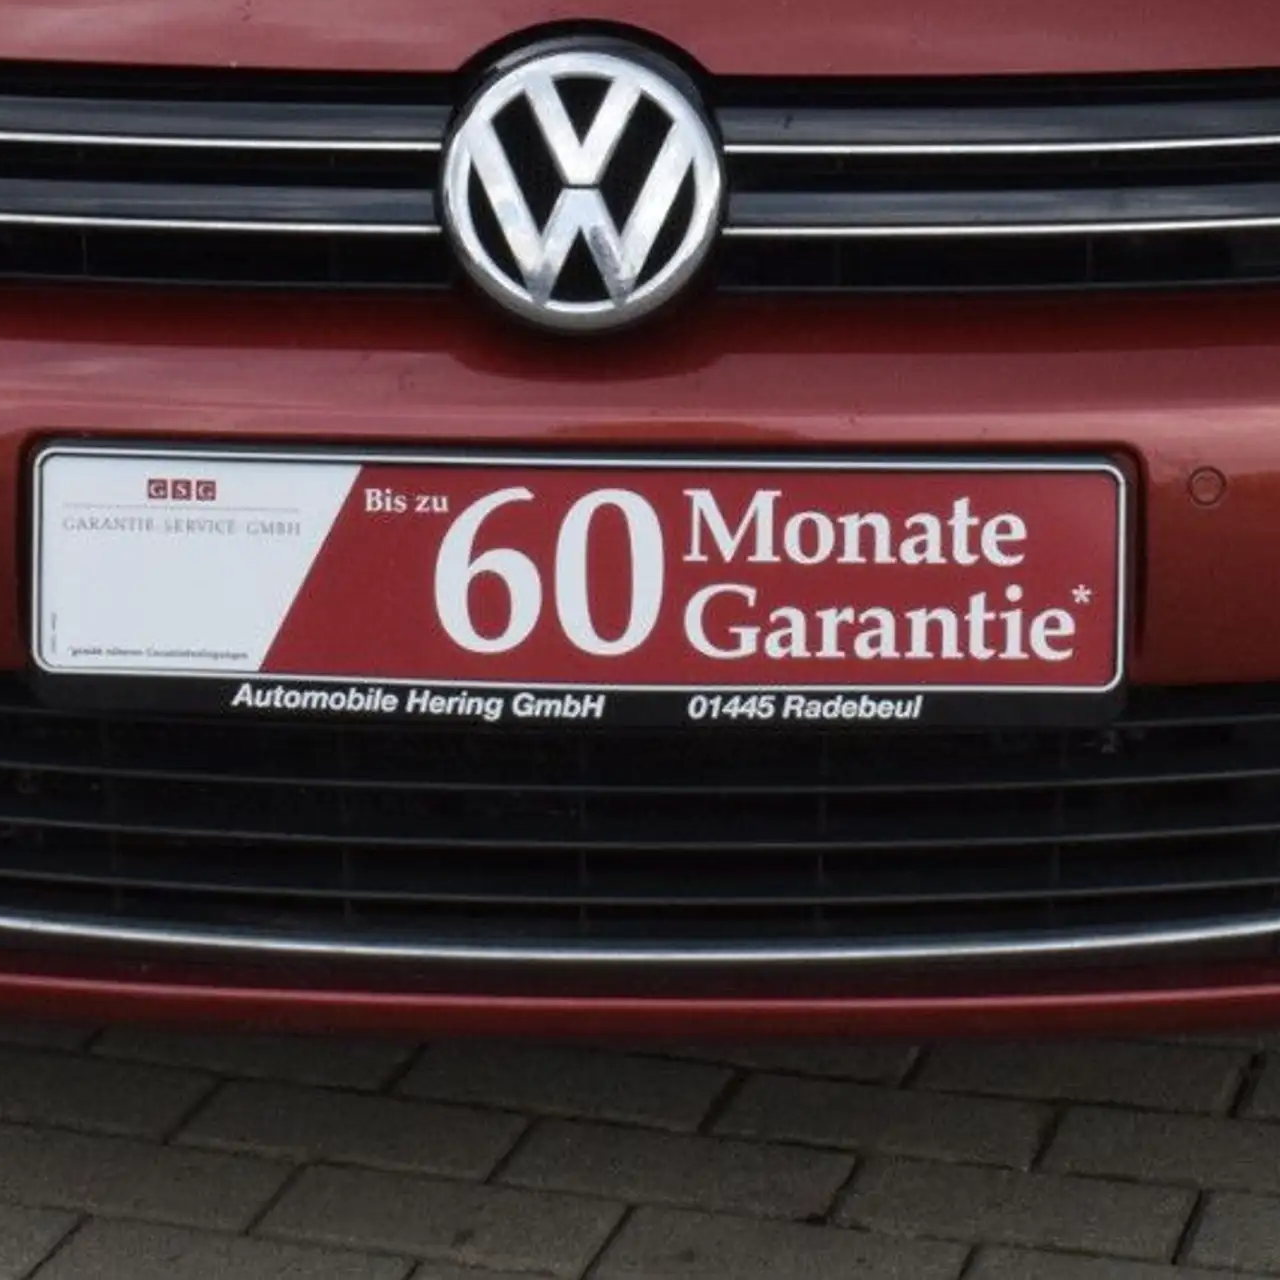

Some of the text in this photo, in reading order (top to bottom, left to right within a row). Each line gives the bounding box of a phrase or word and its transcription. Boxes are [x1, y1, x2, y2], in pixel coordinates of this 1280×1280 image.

[148, 479, 216, 501] GSG
[682, 488, 1028, 567] Monate
[363, 486, 665, 657] Bis zu 60
[231, 681, 923, 721] Automobile Hering GmbH 01445 Radebeul
